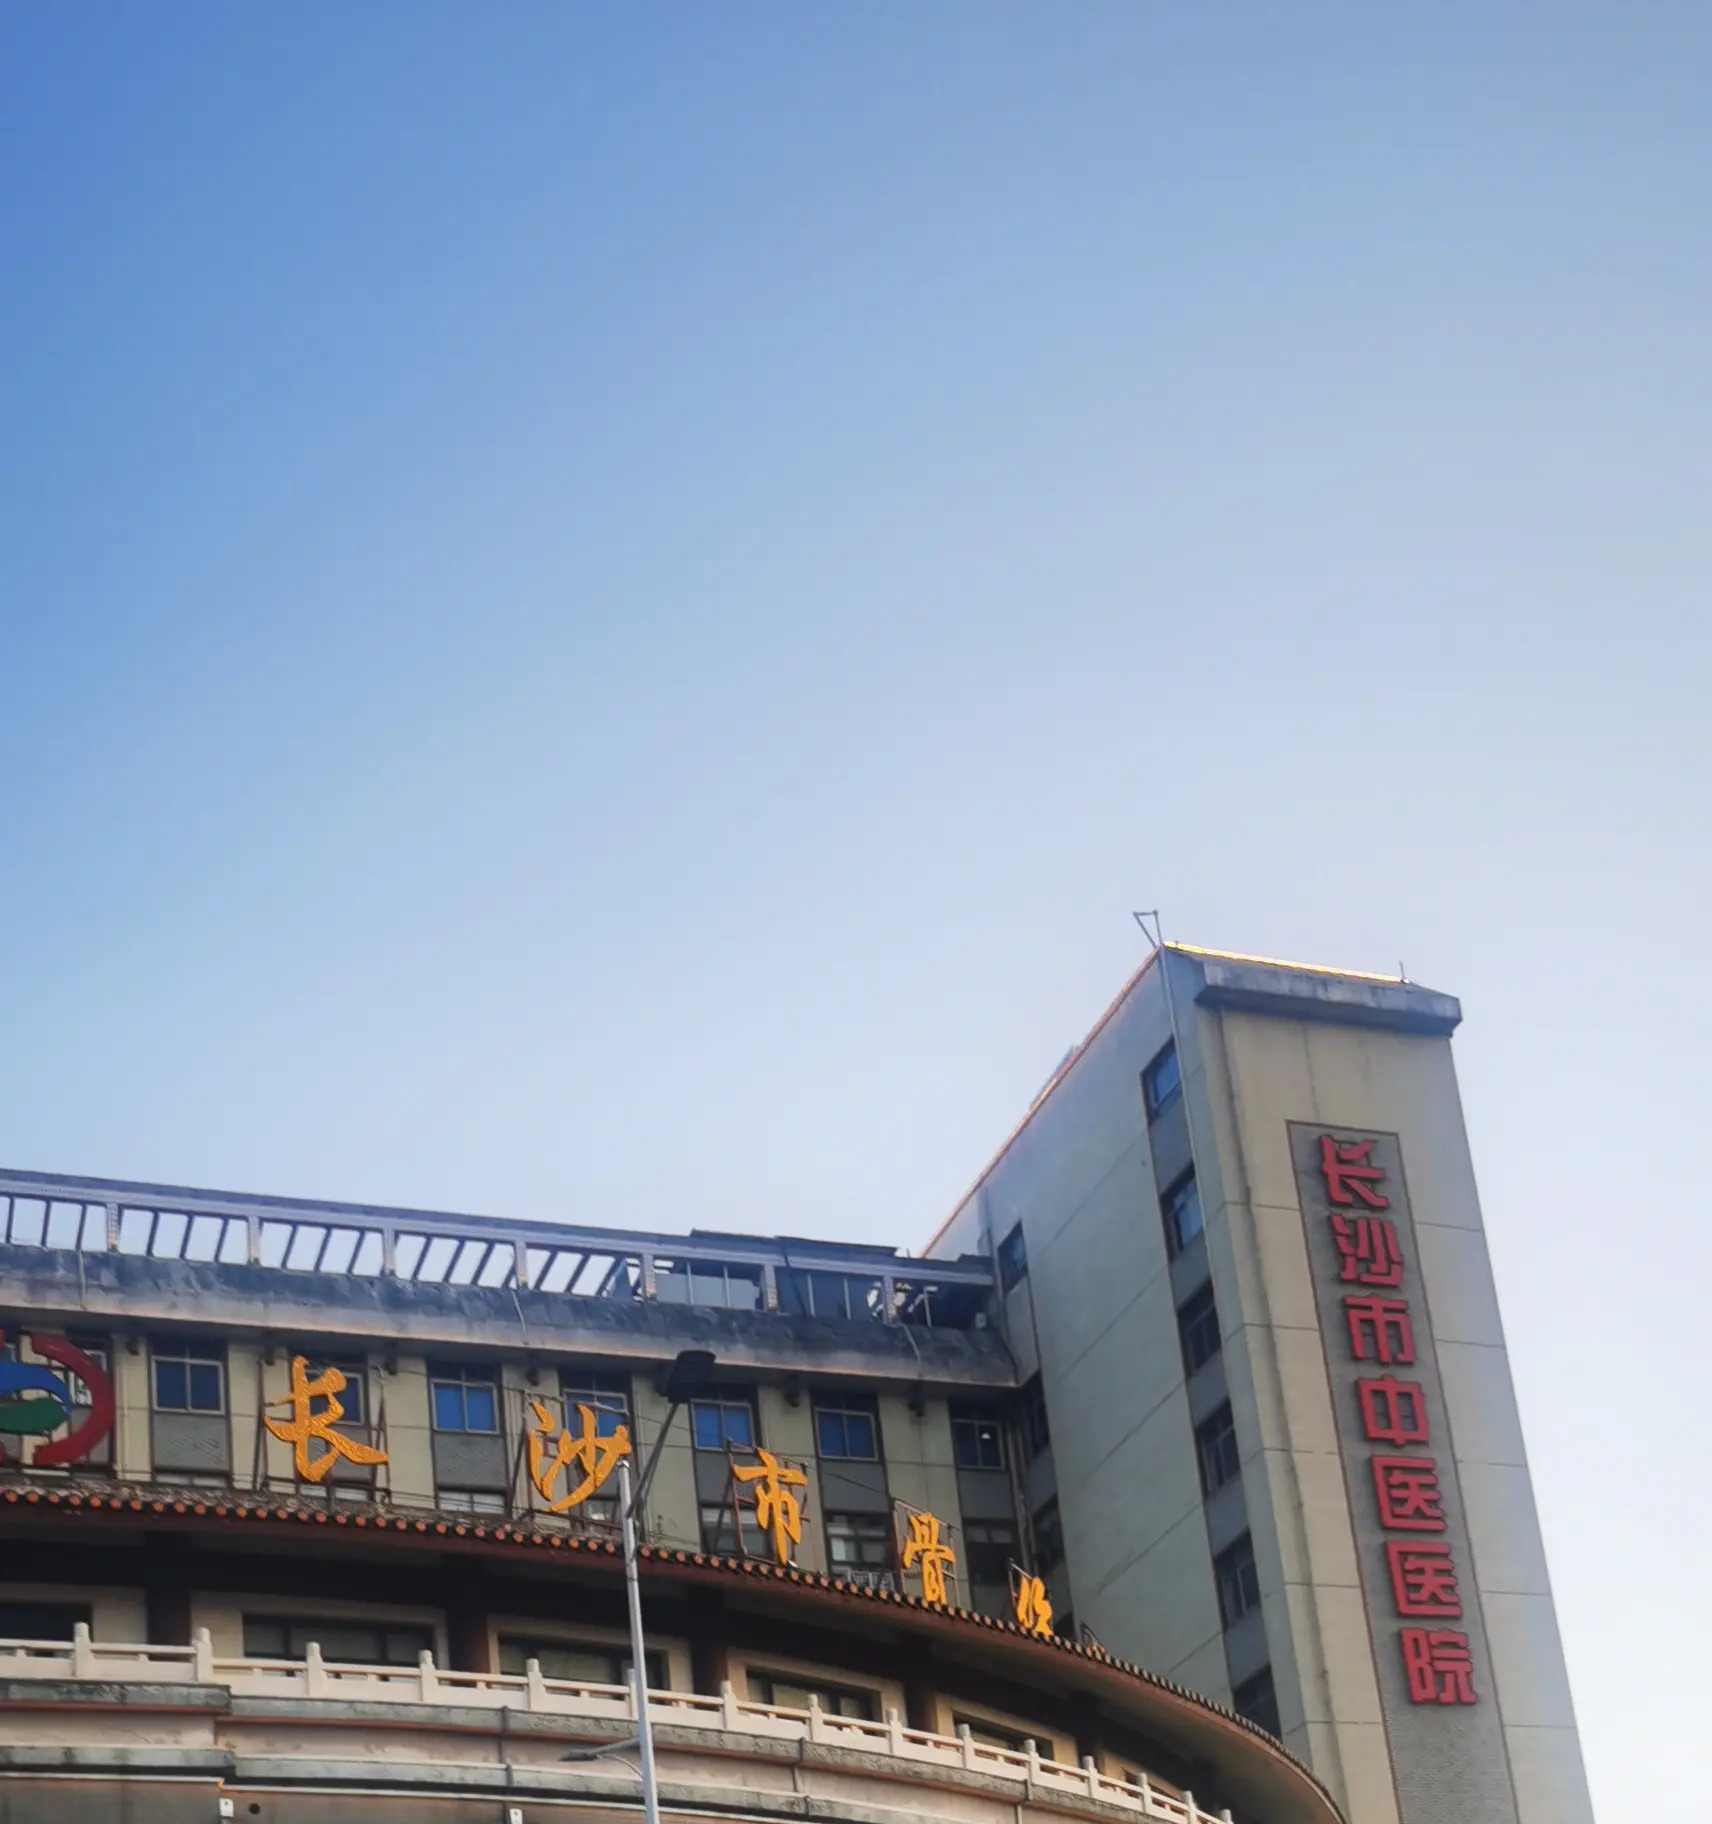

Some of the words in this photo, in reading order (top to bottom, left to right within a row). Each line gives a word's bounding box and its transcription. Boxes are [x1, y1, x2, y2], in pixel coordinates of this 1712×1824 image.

[1319, 1134, 1477, 1706] 长沙市中医医院
